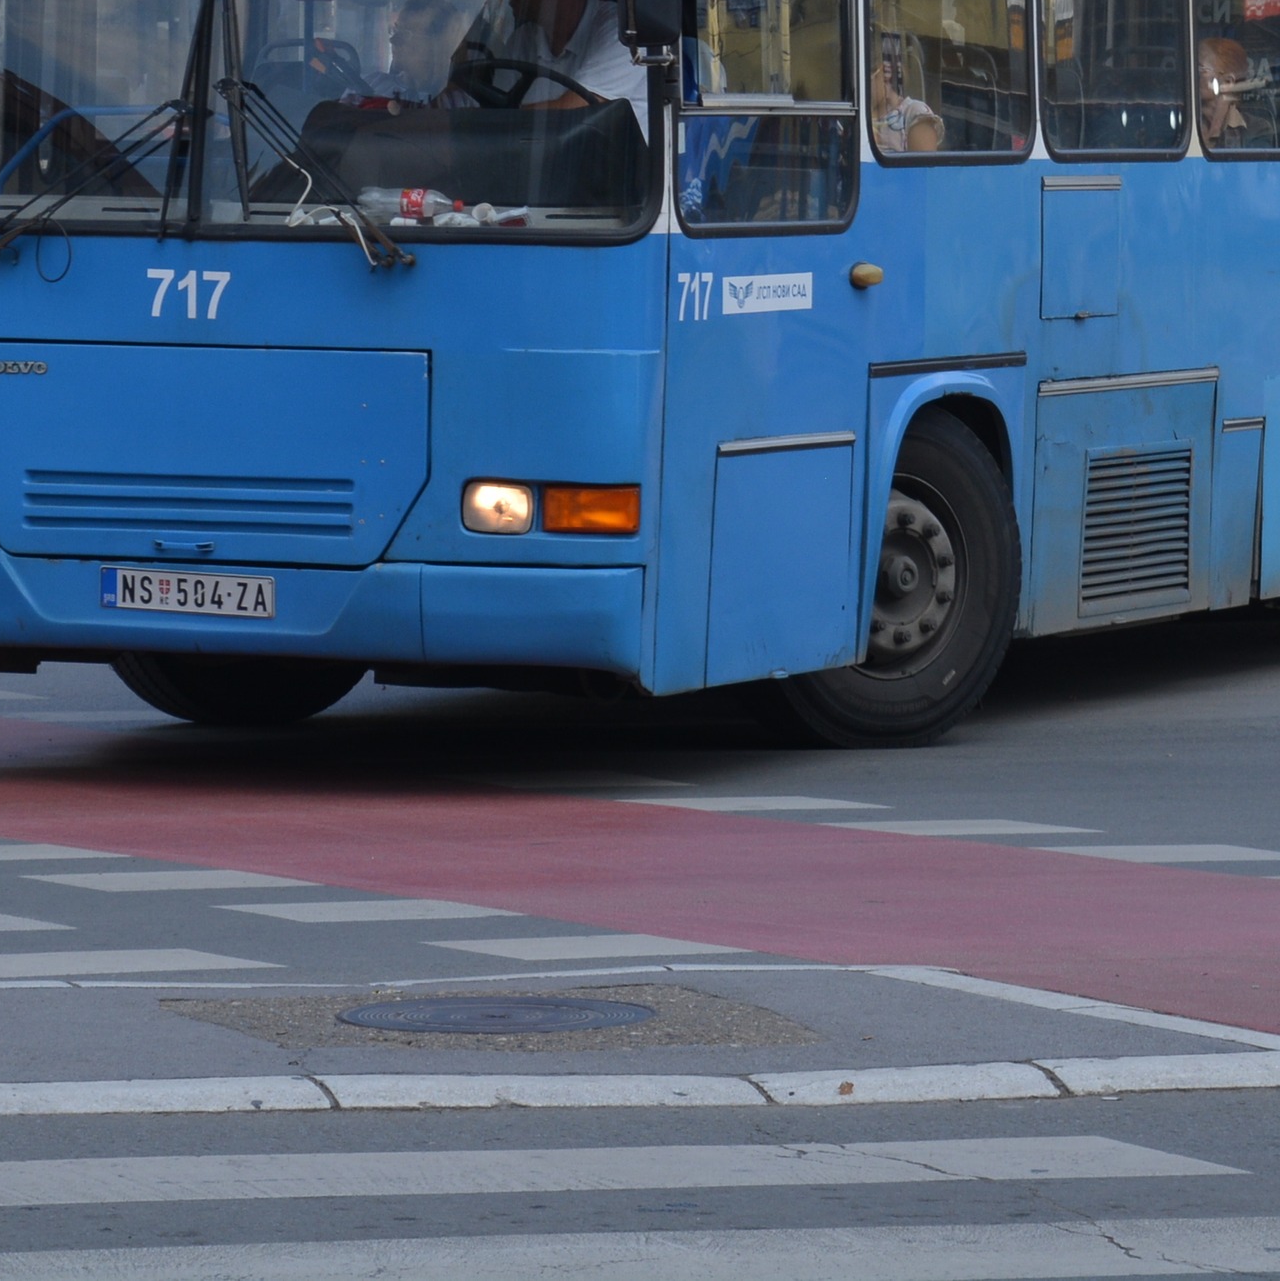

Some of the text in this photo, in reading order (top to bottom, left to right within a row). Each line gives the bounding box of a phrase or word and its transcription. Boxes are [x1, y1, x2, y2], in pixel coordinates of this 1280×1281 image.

[147, 268, 231, 319] 717
[677, 271, 713, 321] 717
[772, 284, 791, 299] НОВИ
[791, 283, 807, 297] САД
[122, 574, 153, 604] NS
